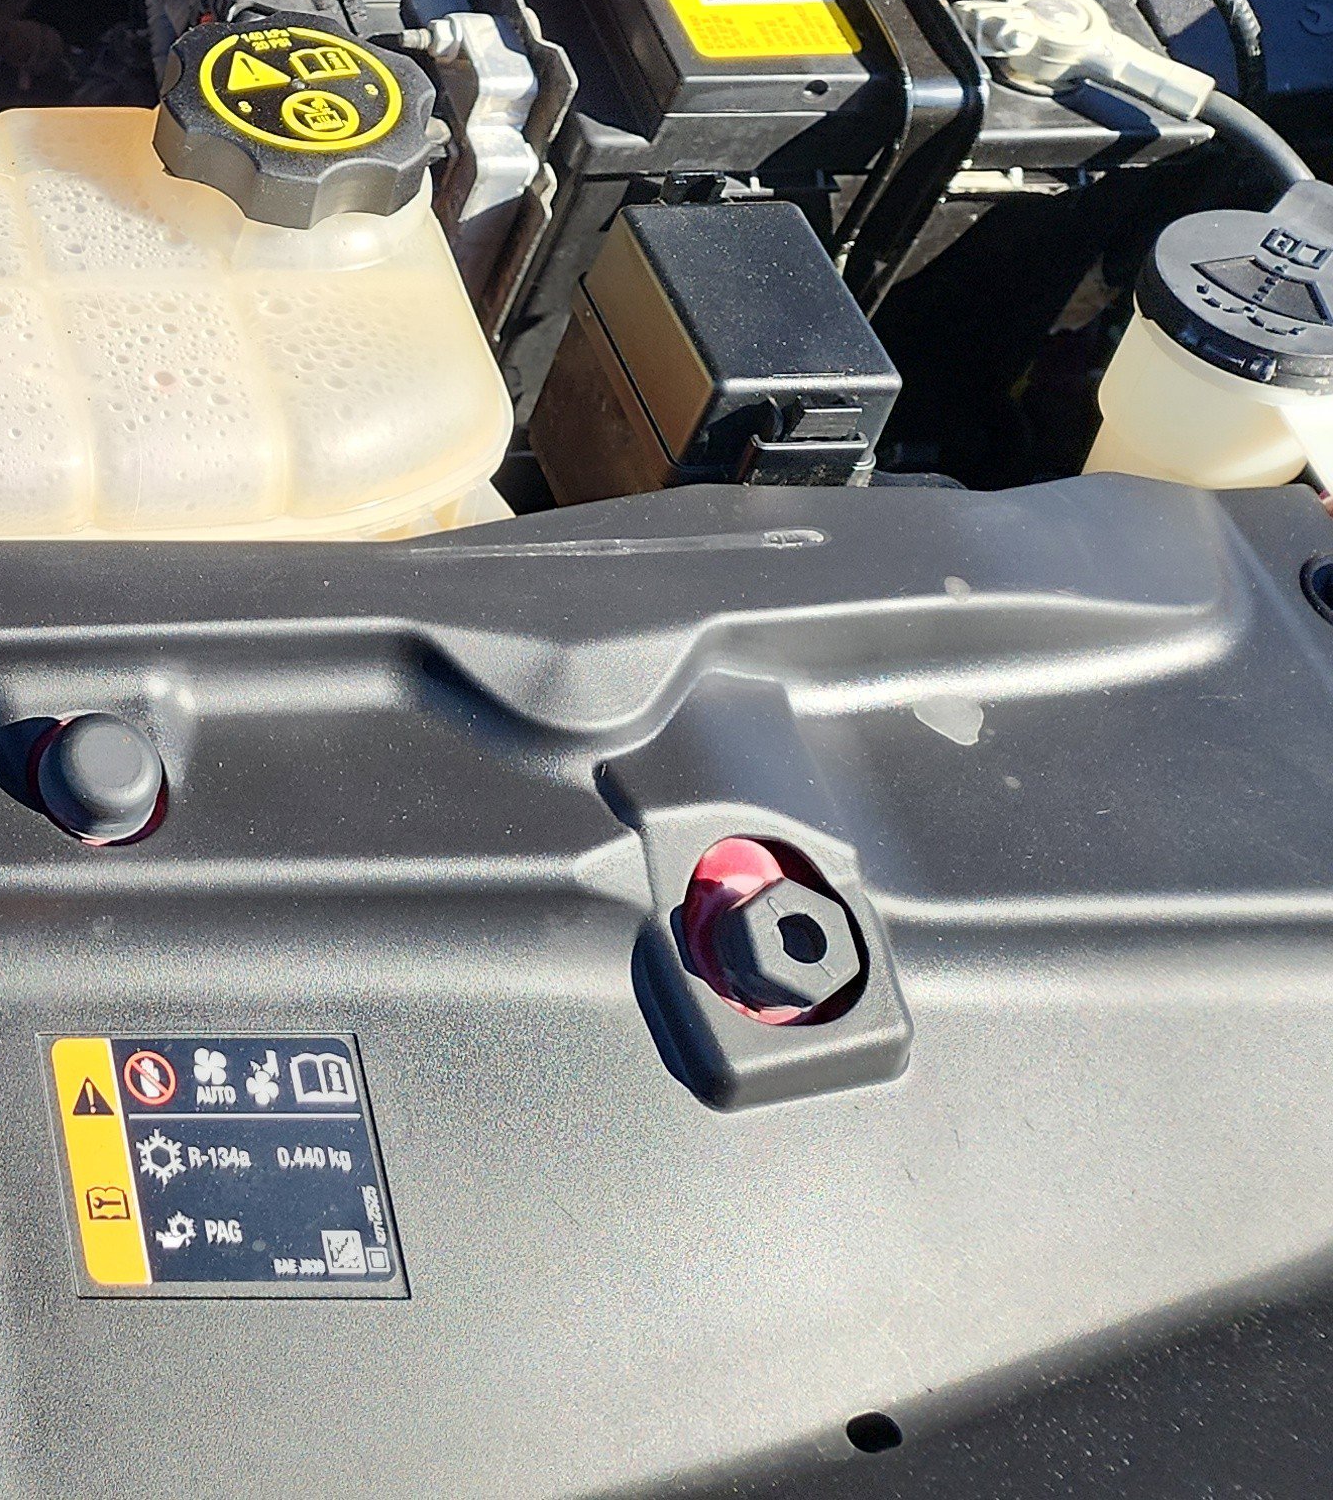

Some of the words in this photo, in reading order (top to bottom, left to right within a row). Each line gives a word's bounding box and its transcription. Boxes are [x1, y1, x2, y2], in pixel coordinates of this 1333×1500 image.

[251, 41, 271, 51] 20
[196, 1085, 237, 1105] AUTO
[187, 1146, 252, 1168] R-134a
[277, 1146, 326, 1169] 0.440
[327, 1146, 352, 1173] kg
[204, 1219, 243, 1244] PAG
